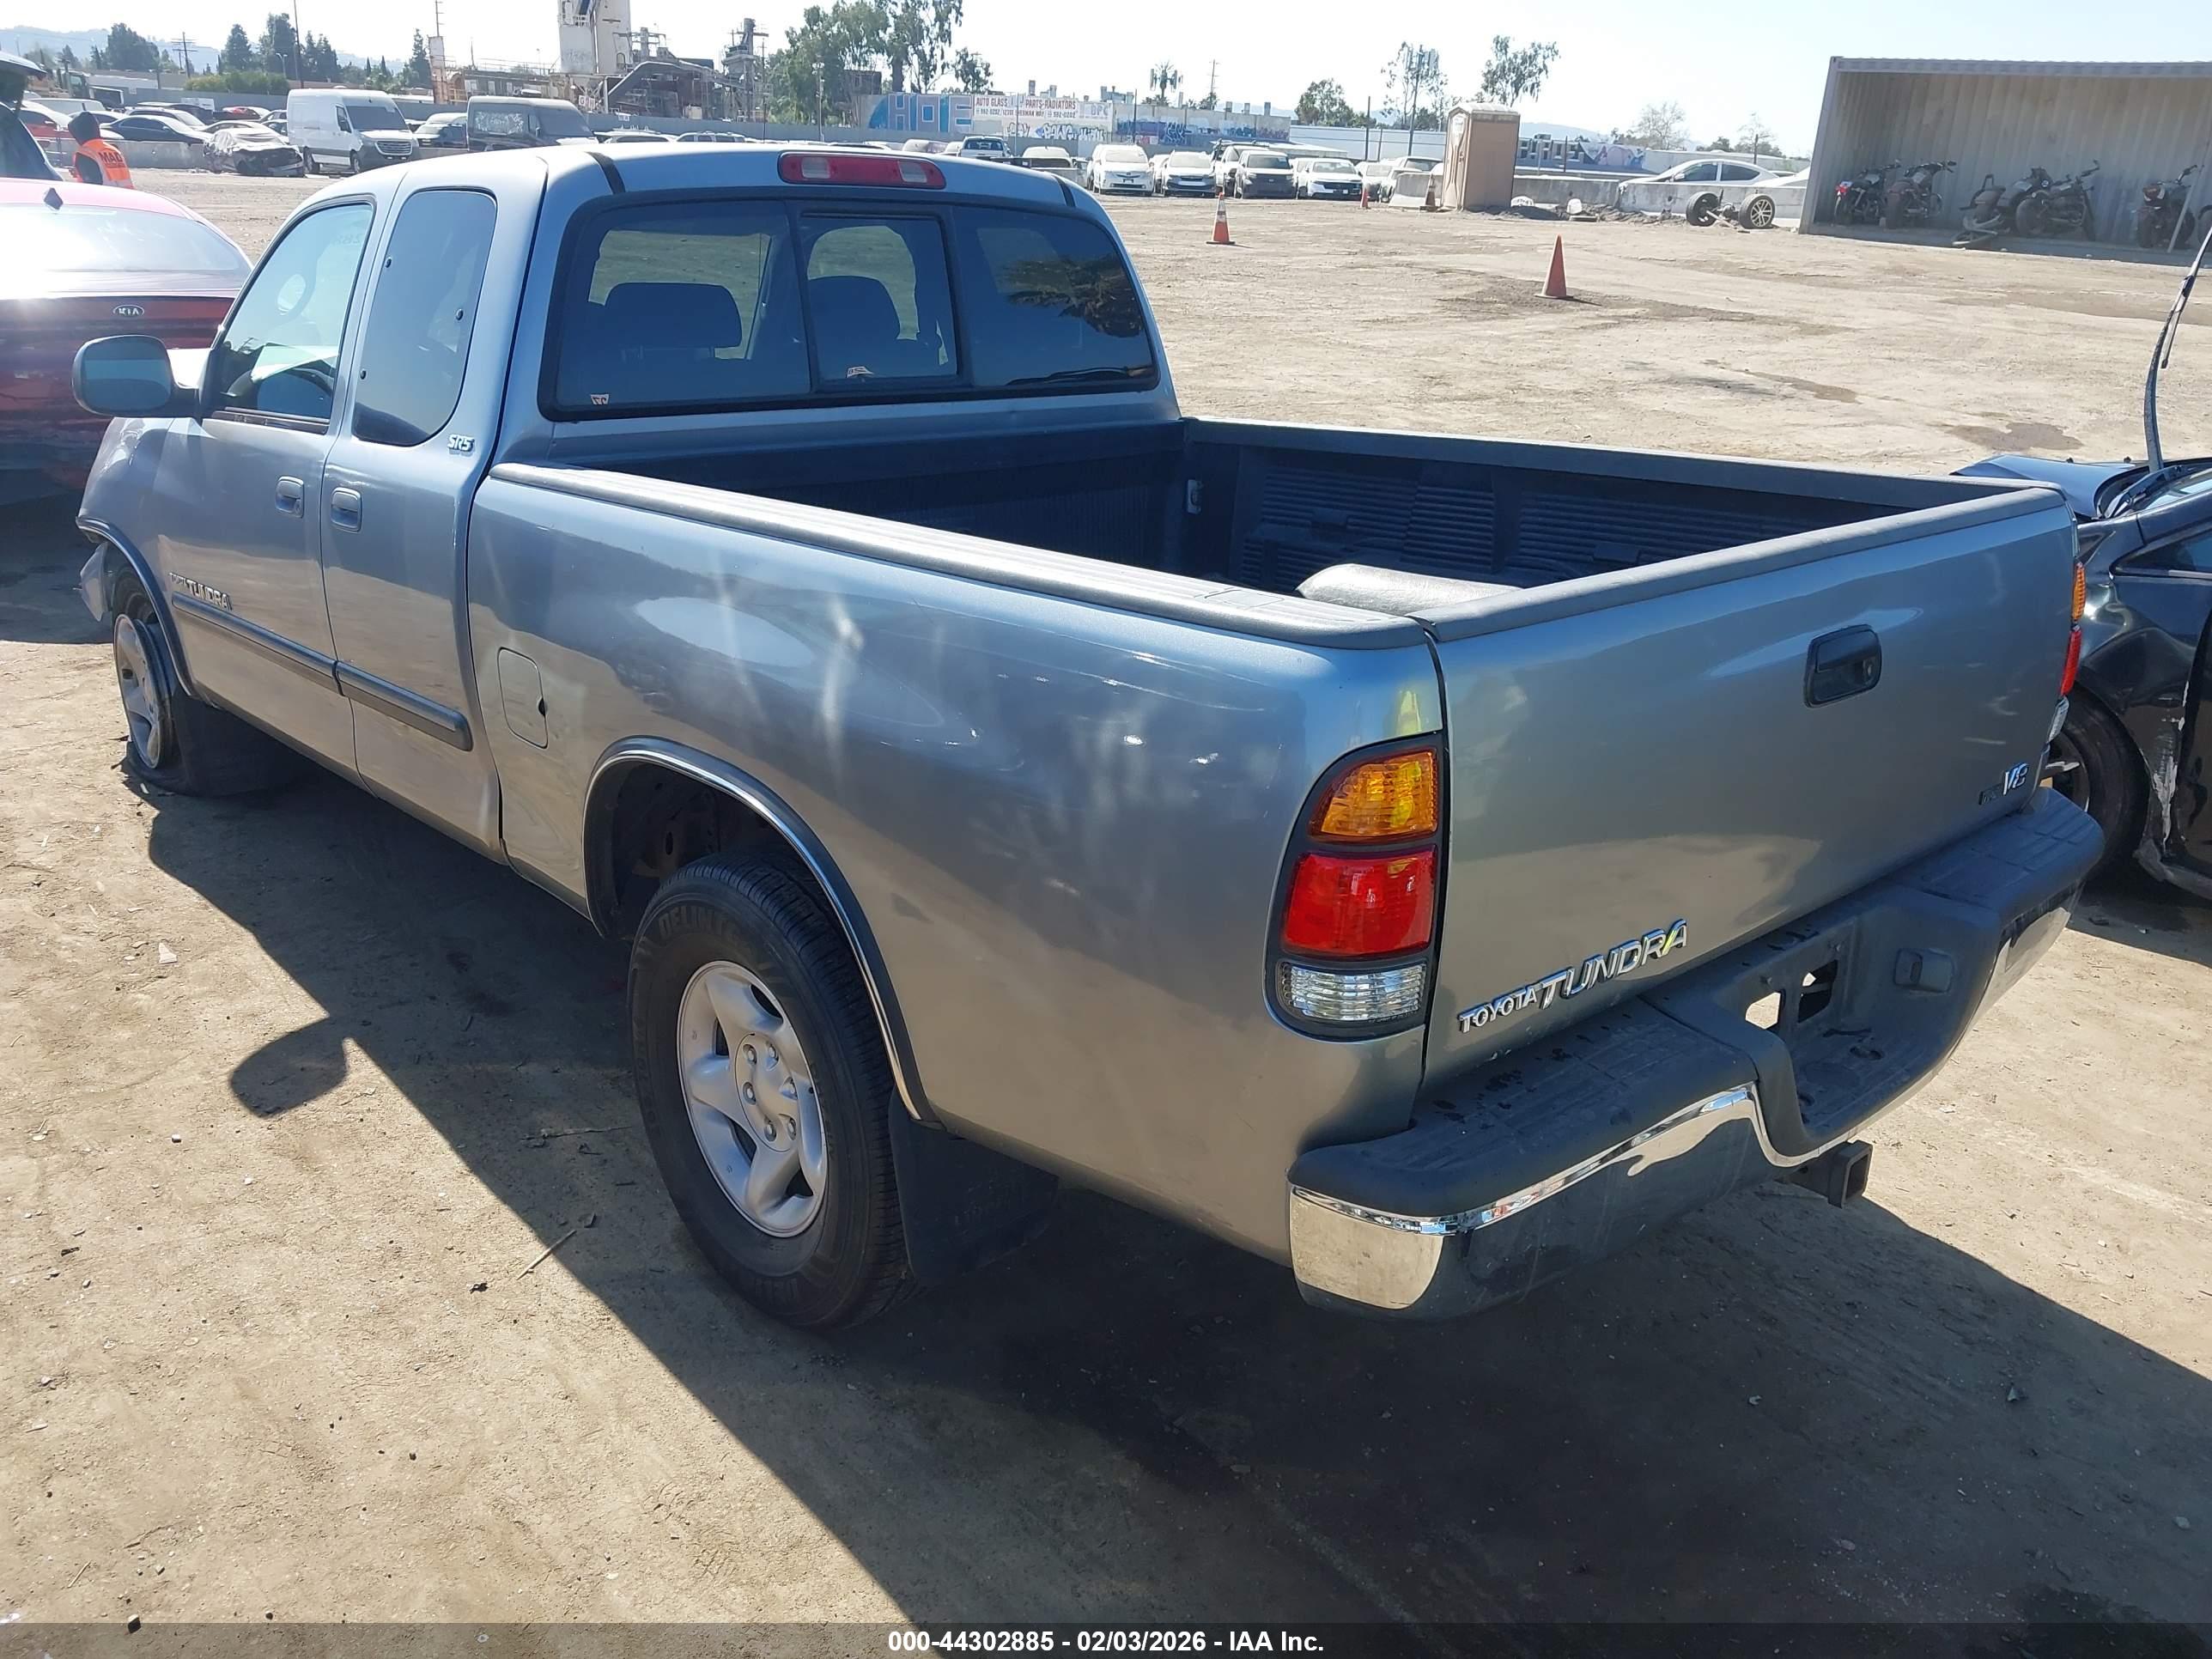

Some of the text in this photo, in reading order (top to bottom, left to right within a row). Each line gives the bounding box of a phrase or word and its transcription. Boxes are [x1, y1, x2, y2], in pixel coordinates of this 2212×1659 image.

[975, 97, 1008, 107] AUTO GLASS
[447, 434, 475, 452] SR5
[185, 577, 233, 611] TUNDRA
[1457, 918, 1687, 1033] TOYOTA TUNDRA
